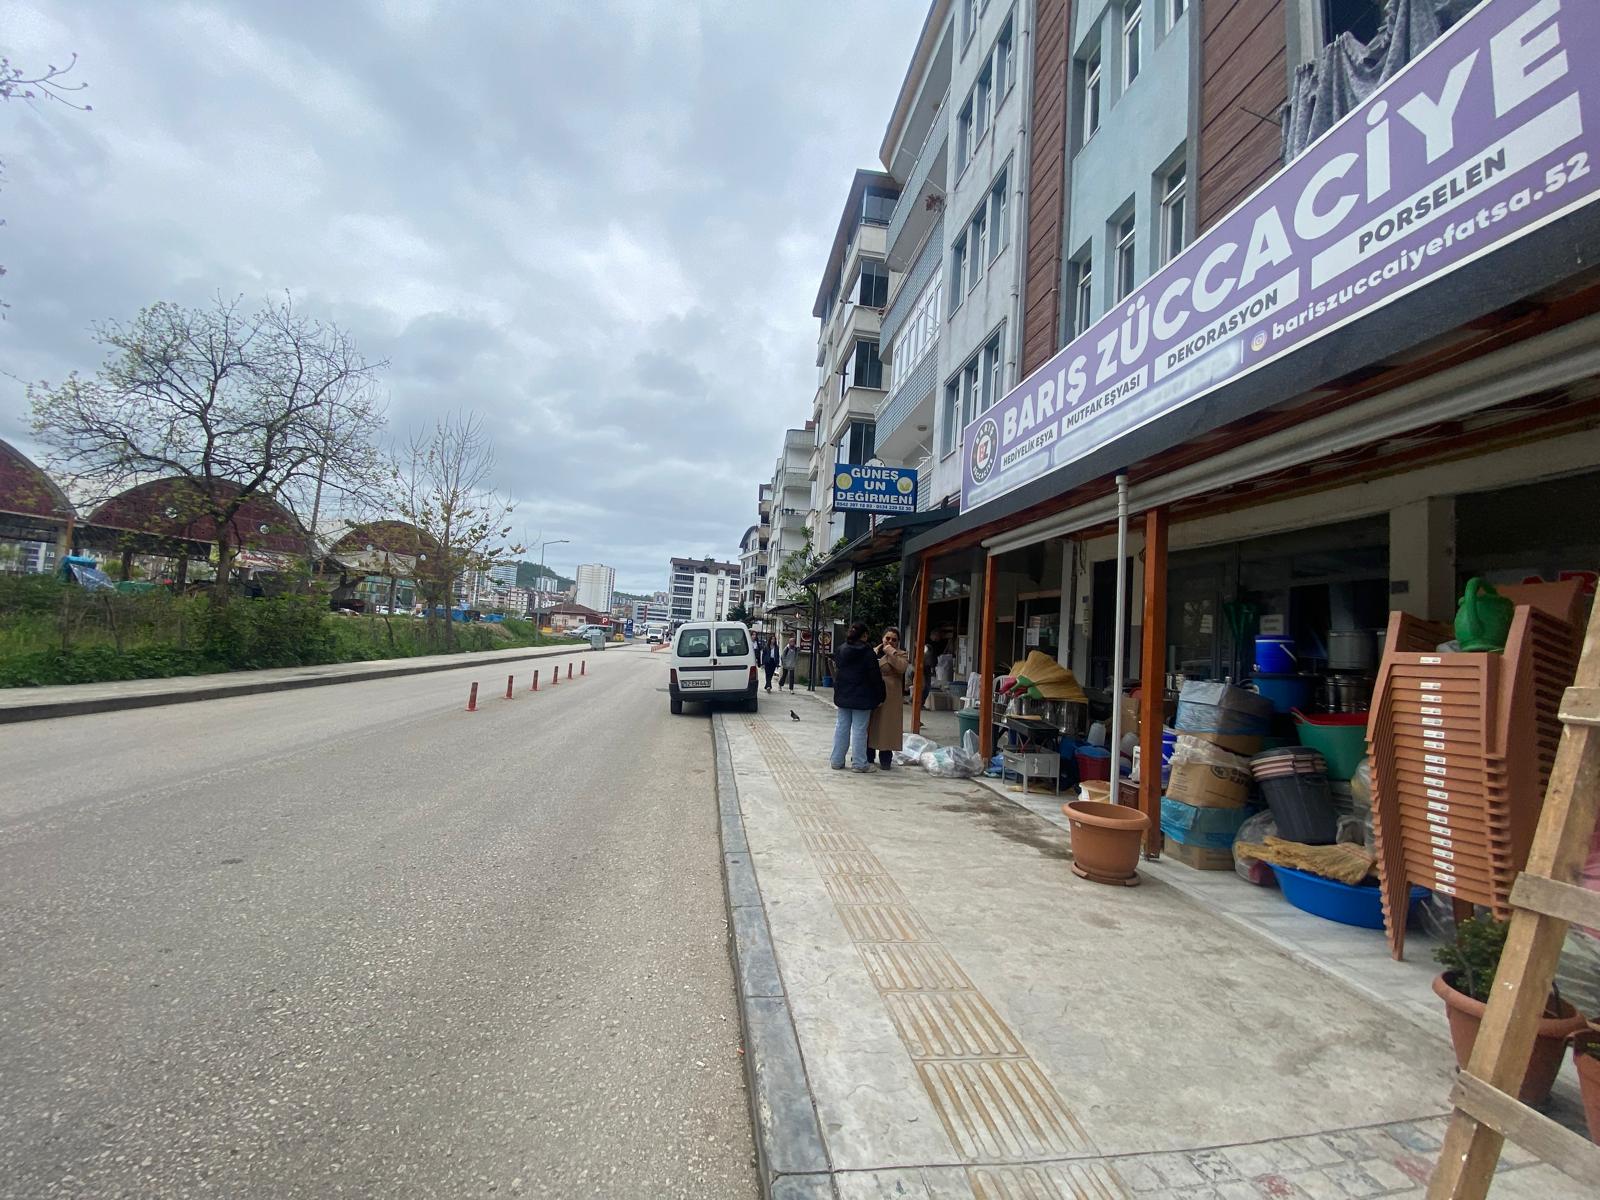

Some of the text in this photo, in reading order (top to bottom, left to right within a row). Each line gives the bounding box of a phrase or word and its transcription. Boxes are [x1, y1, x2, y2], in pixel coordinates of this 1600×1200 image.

[1002, 0, 1569, 447] BARIŞ ZÜCCACİYE
[1358, 148, 1506, 254] PORSELEN
[1272, 151, 1591, 340] bariszuccaiyefatsa.52
[1167, 288, 1278, 369] DEKORASYON
[1066, 374, 1141, 428] MUTFAK EŞYASI
[1003, 429, 1053, 466] HEDİYELİK EŞYA
[836, 490, 913, 505] DEĞİRMENİ
[850, 467, 899, 483] GÜNEŞ
[864, 481, 886, 490] UN
